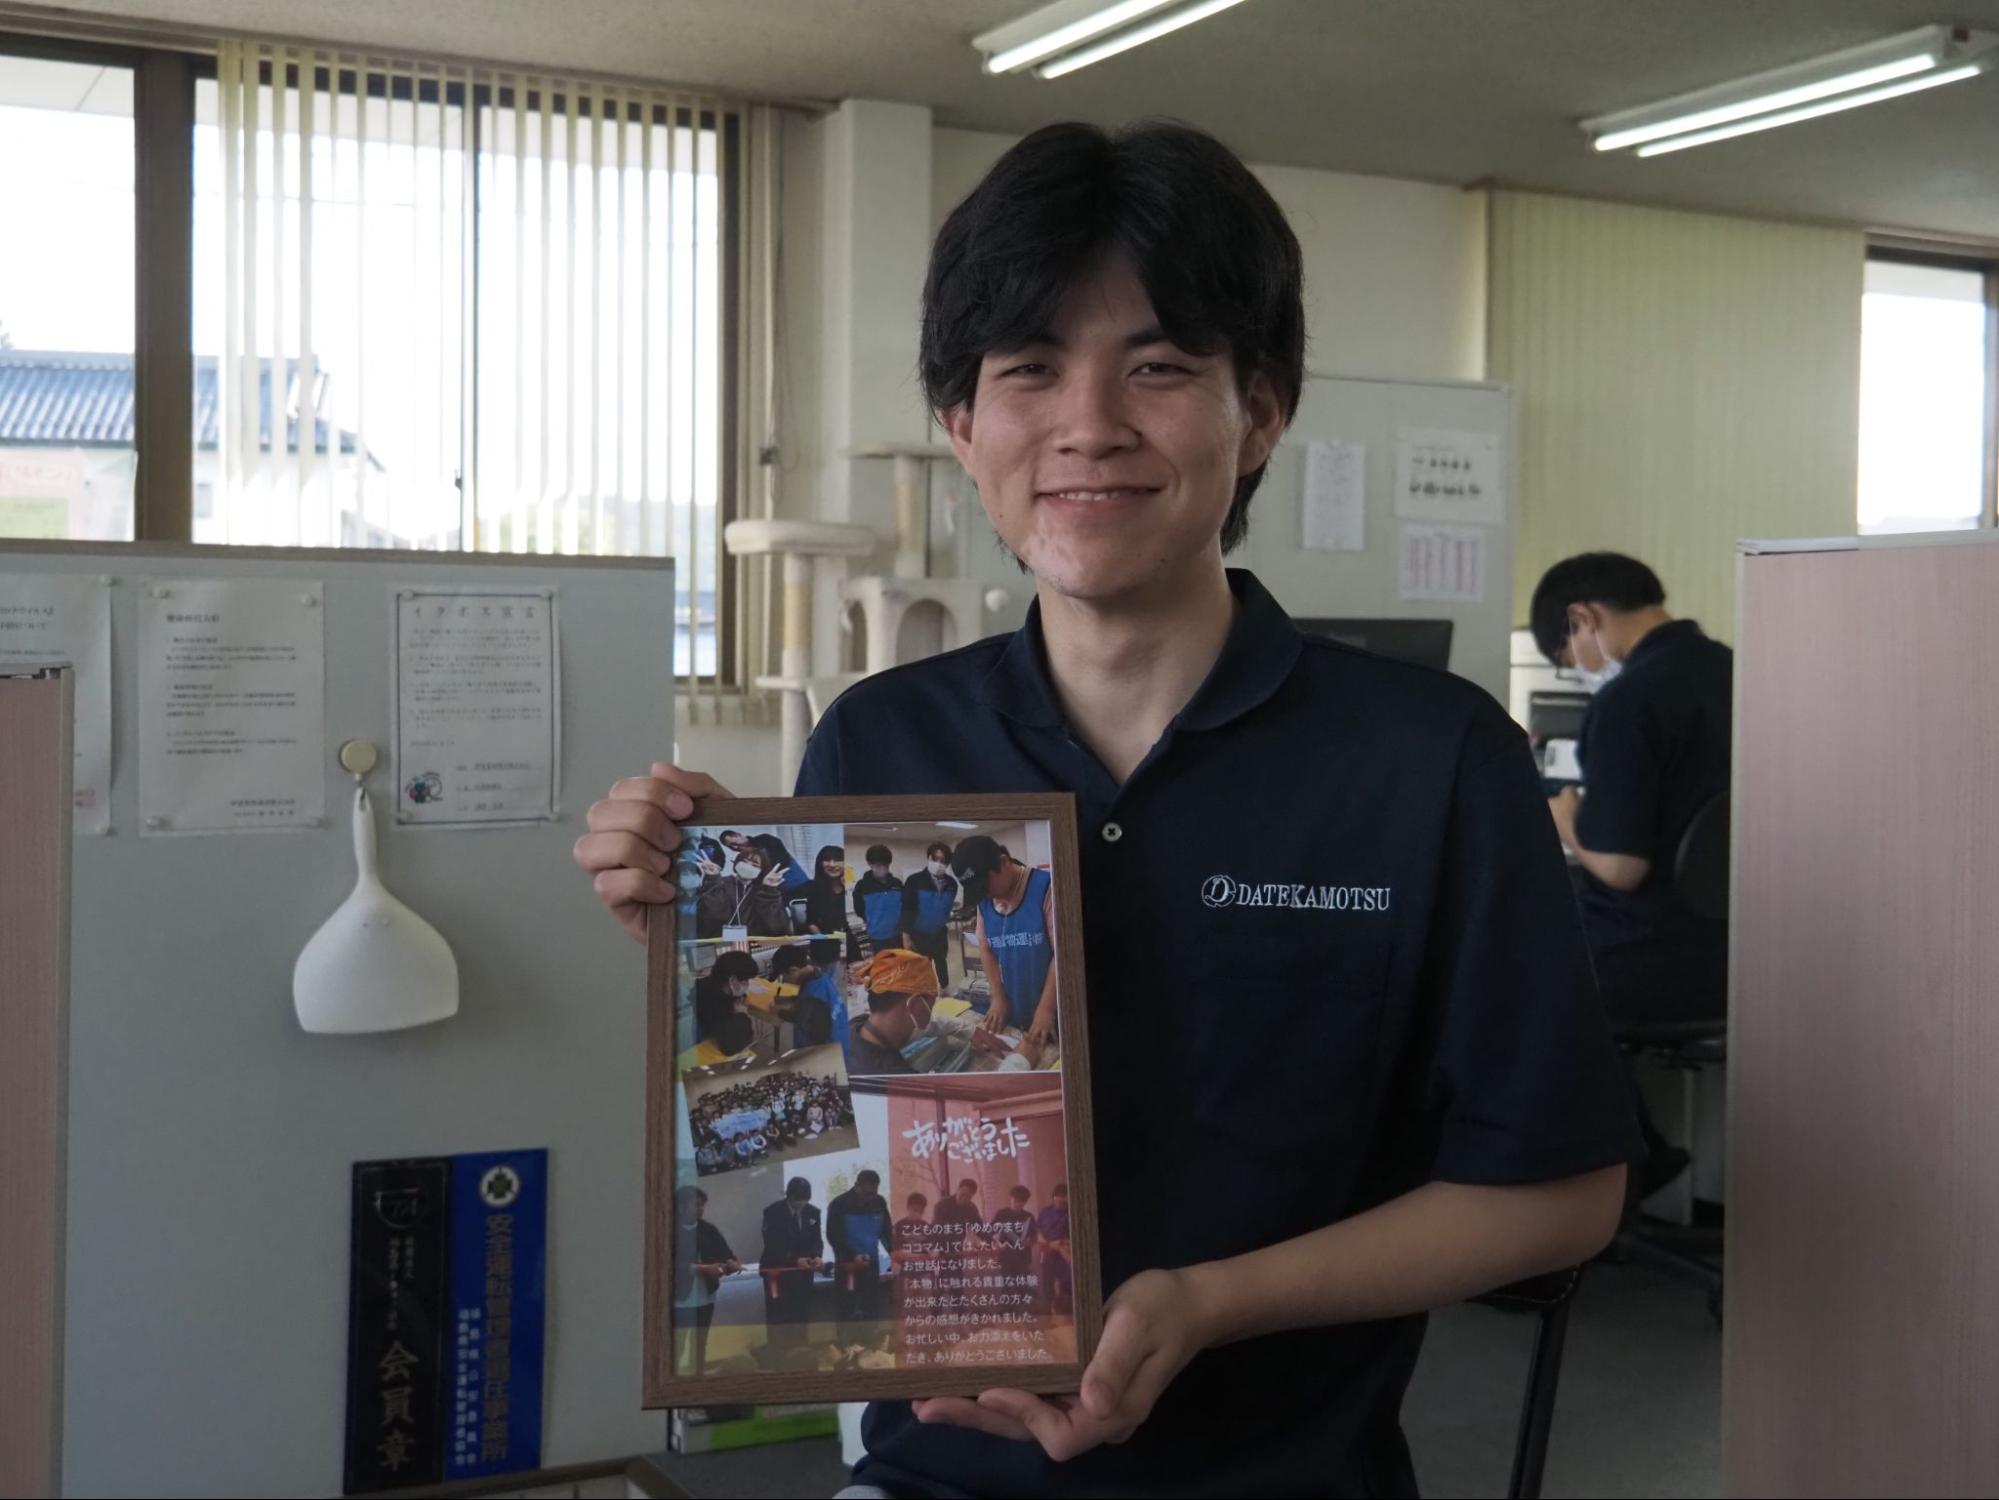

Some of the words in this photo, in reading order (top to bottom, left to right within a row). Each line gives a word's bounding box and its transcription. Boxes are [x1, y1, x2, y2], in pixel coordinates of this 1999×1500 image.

[1235, 883, 1391, 911] DATEKAMOTSU
[902, 1221, 1025, 1236] こどものまち「ゆめのまち
[903, 1257, 1002, 1272] お世話になりました。
[903, 1293, 1033, 1308] が出来たとたくさんの方々
[378, 1341, 420, 1471] 会員章
